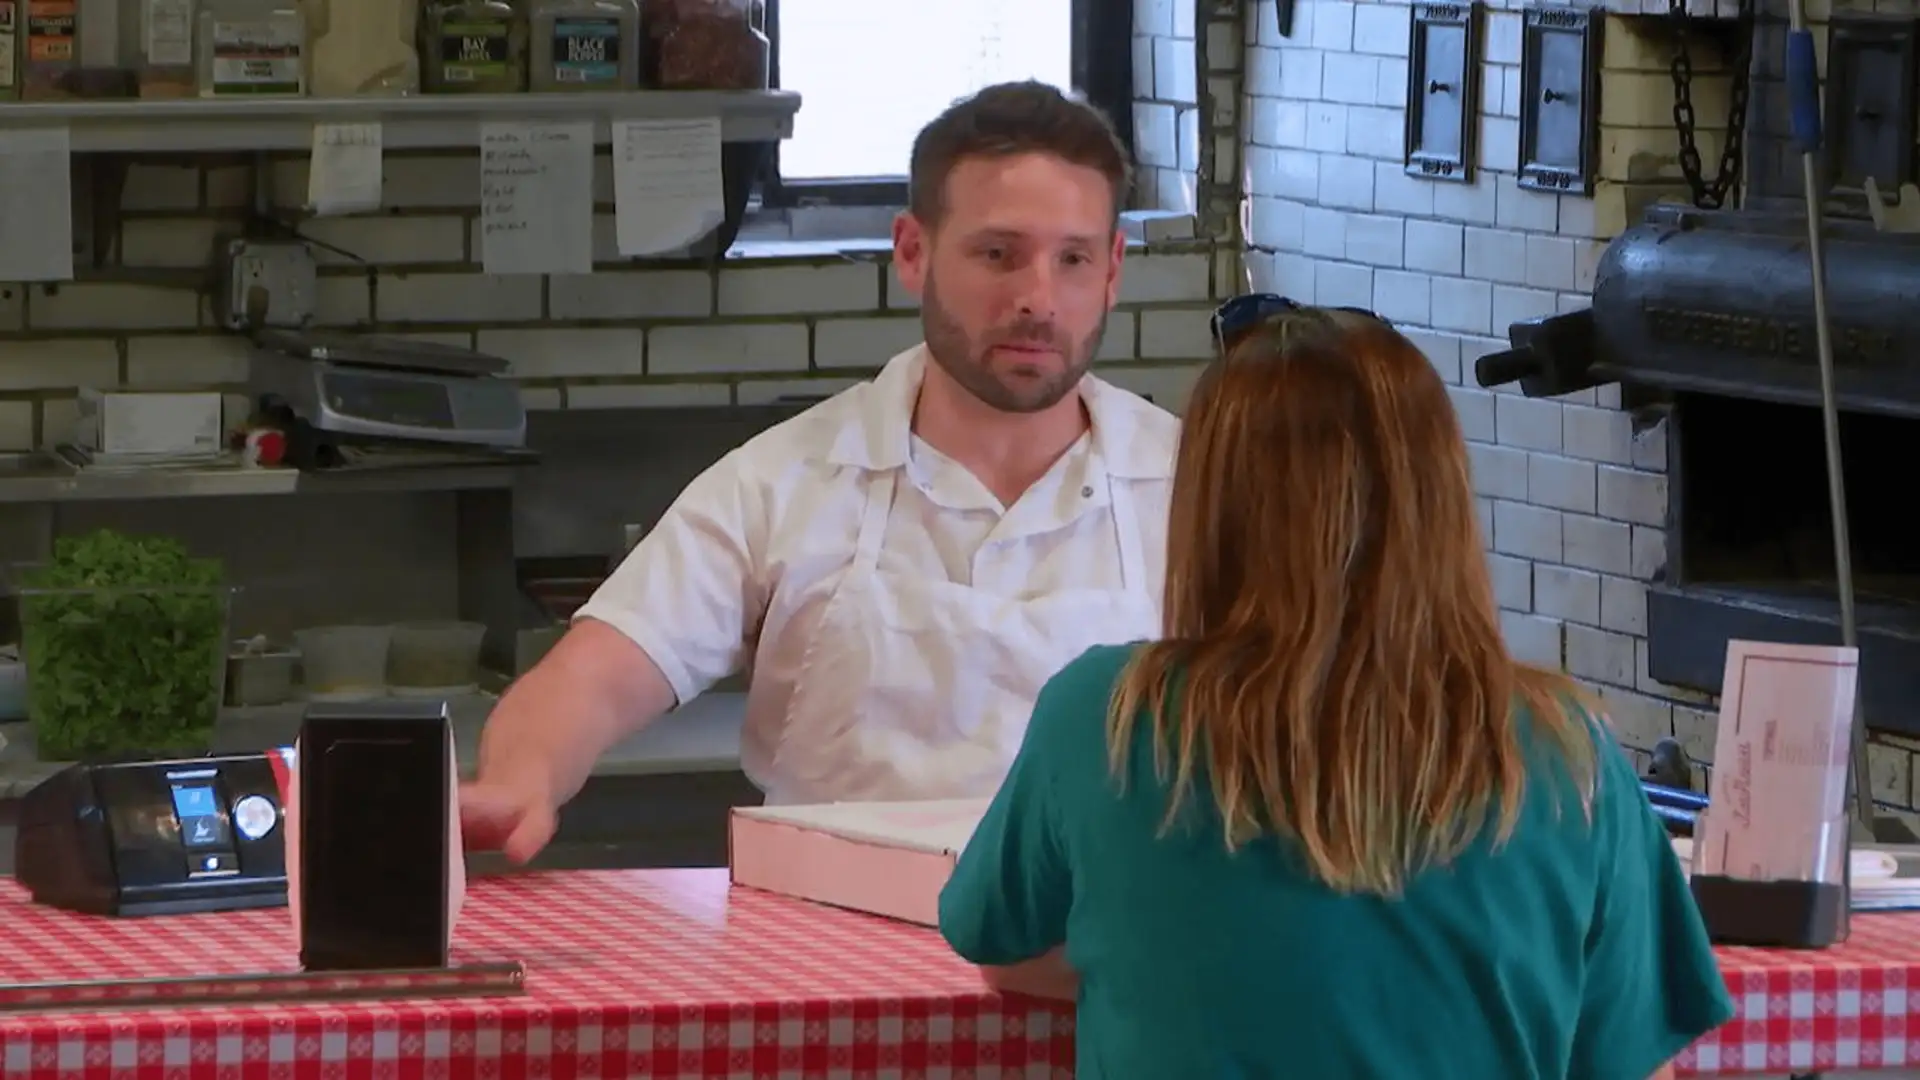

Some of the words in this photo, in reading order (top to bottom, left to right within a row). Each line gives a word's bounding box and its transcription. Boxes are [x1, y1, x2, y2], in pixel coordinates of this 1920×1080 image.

[462, 35, 488, 50] BAY
[568, 36, 605, 50] BLACK
[568, 49, 605, 61] PEPPER
